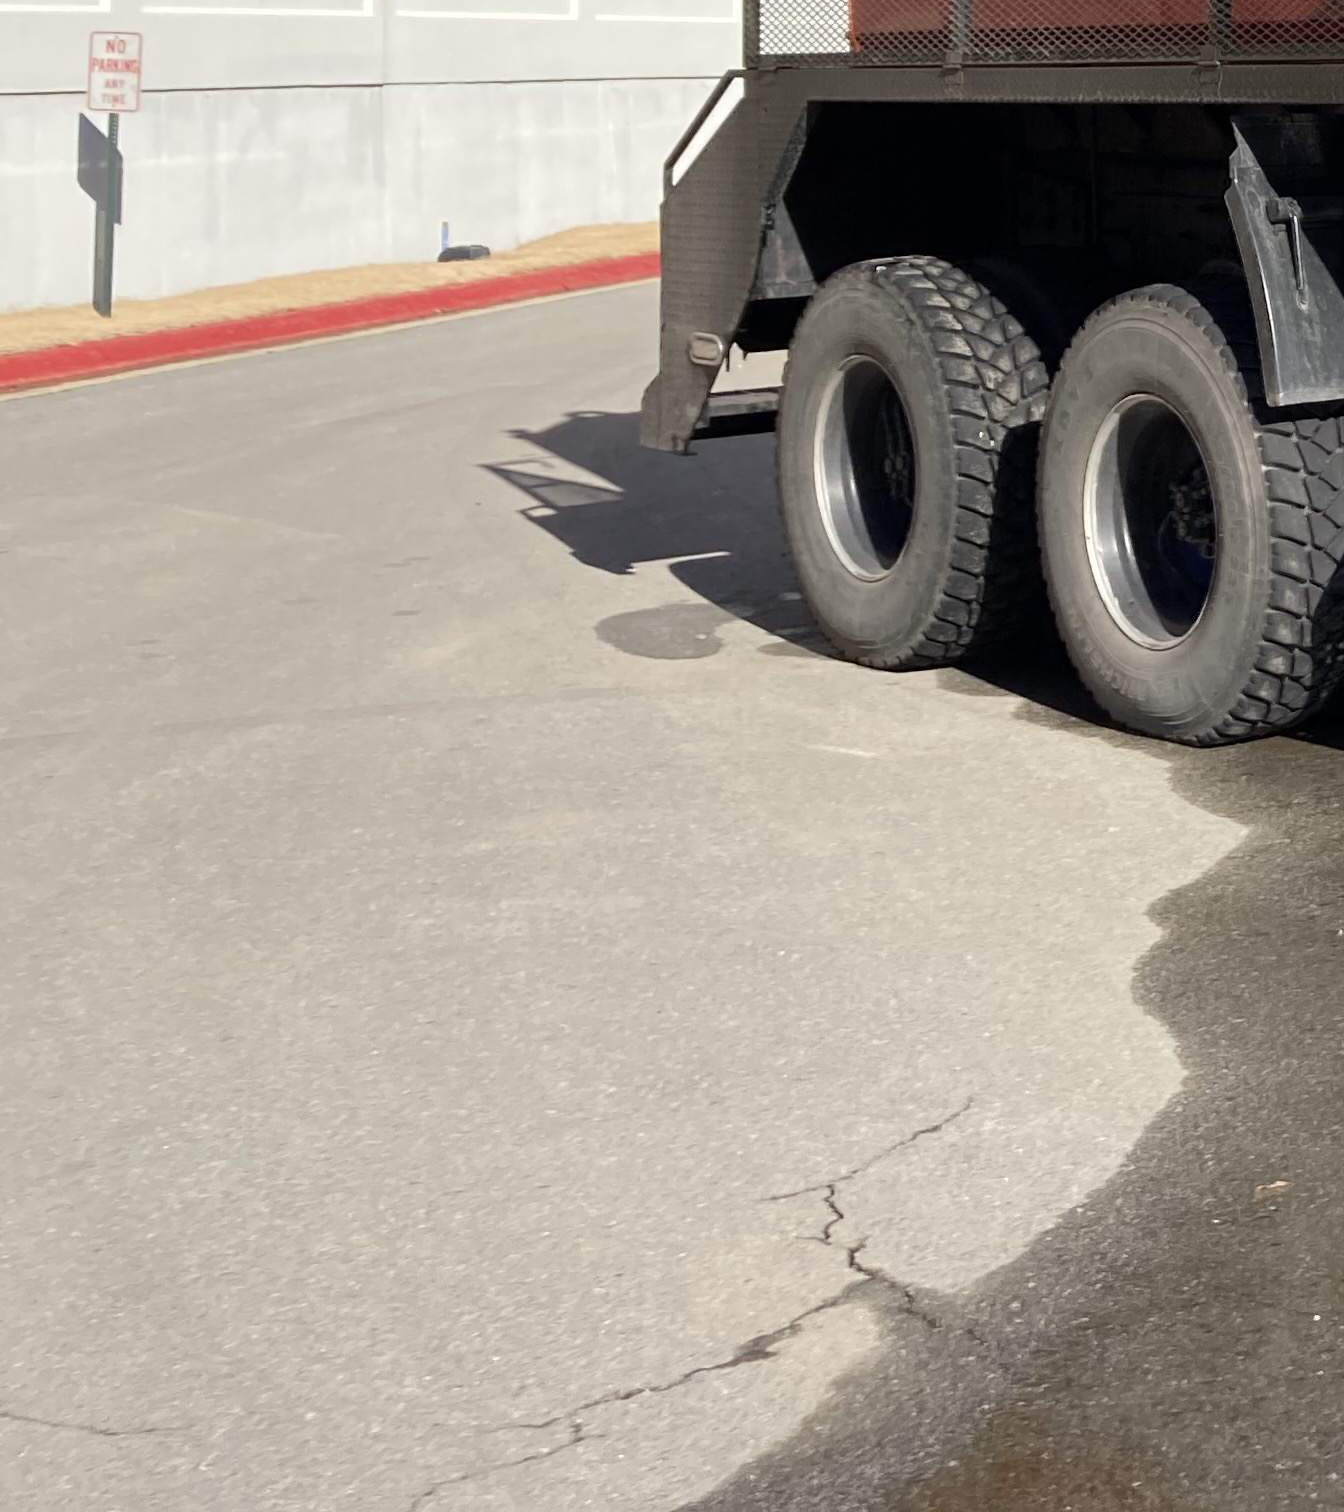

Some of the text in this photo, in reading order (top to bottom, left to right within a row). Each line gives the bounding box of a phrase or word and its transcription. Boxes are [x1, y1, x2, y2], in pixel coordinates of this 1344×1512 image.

[105, 39, 126, 54] NO
[90, 57, 140, 74] PARKING
[104, 79, 126, 89] ANY
